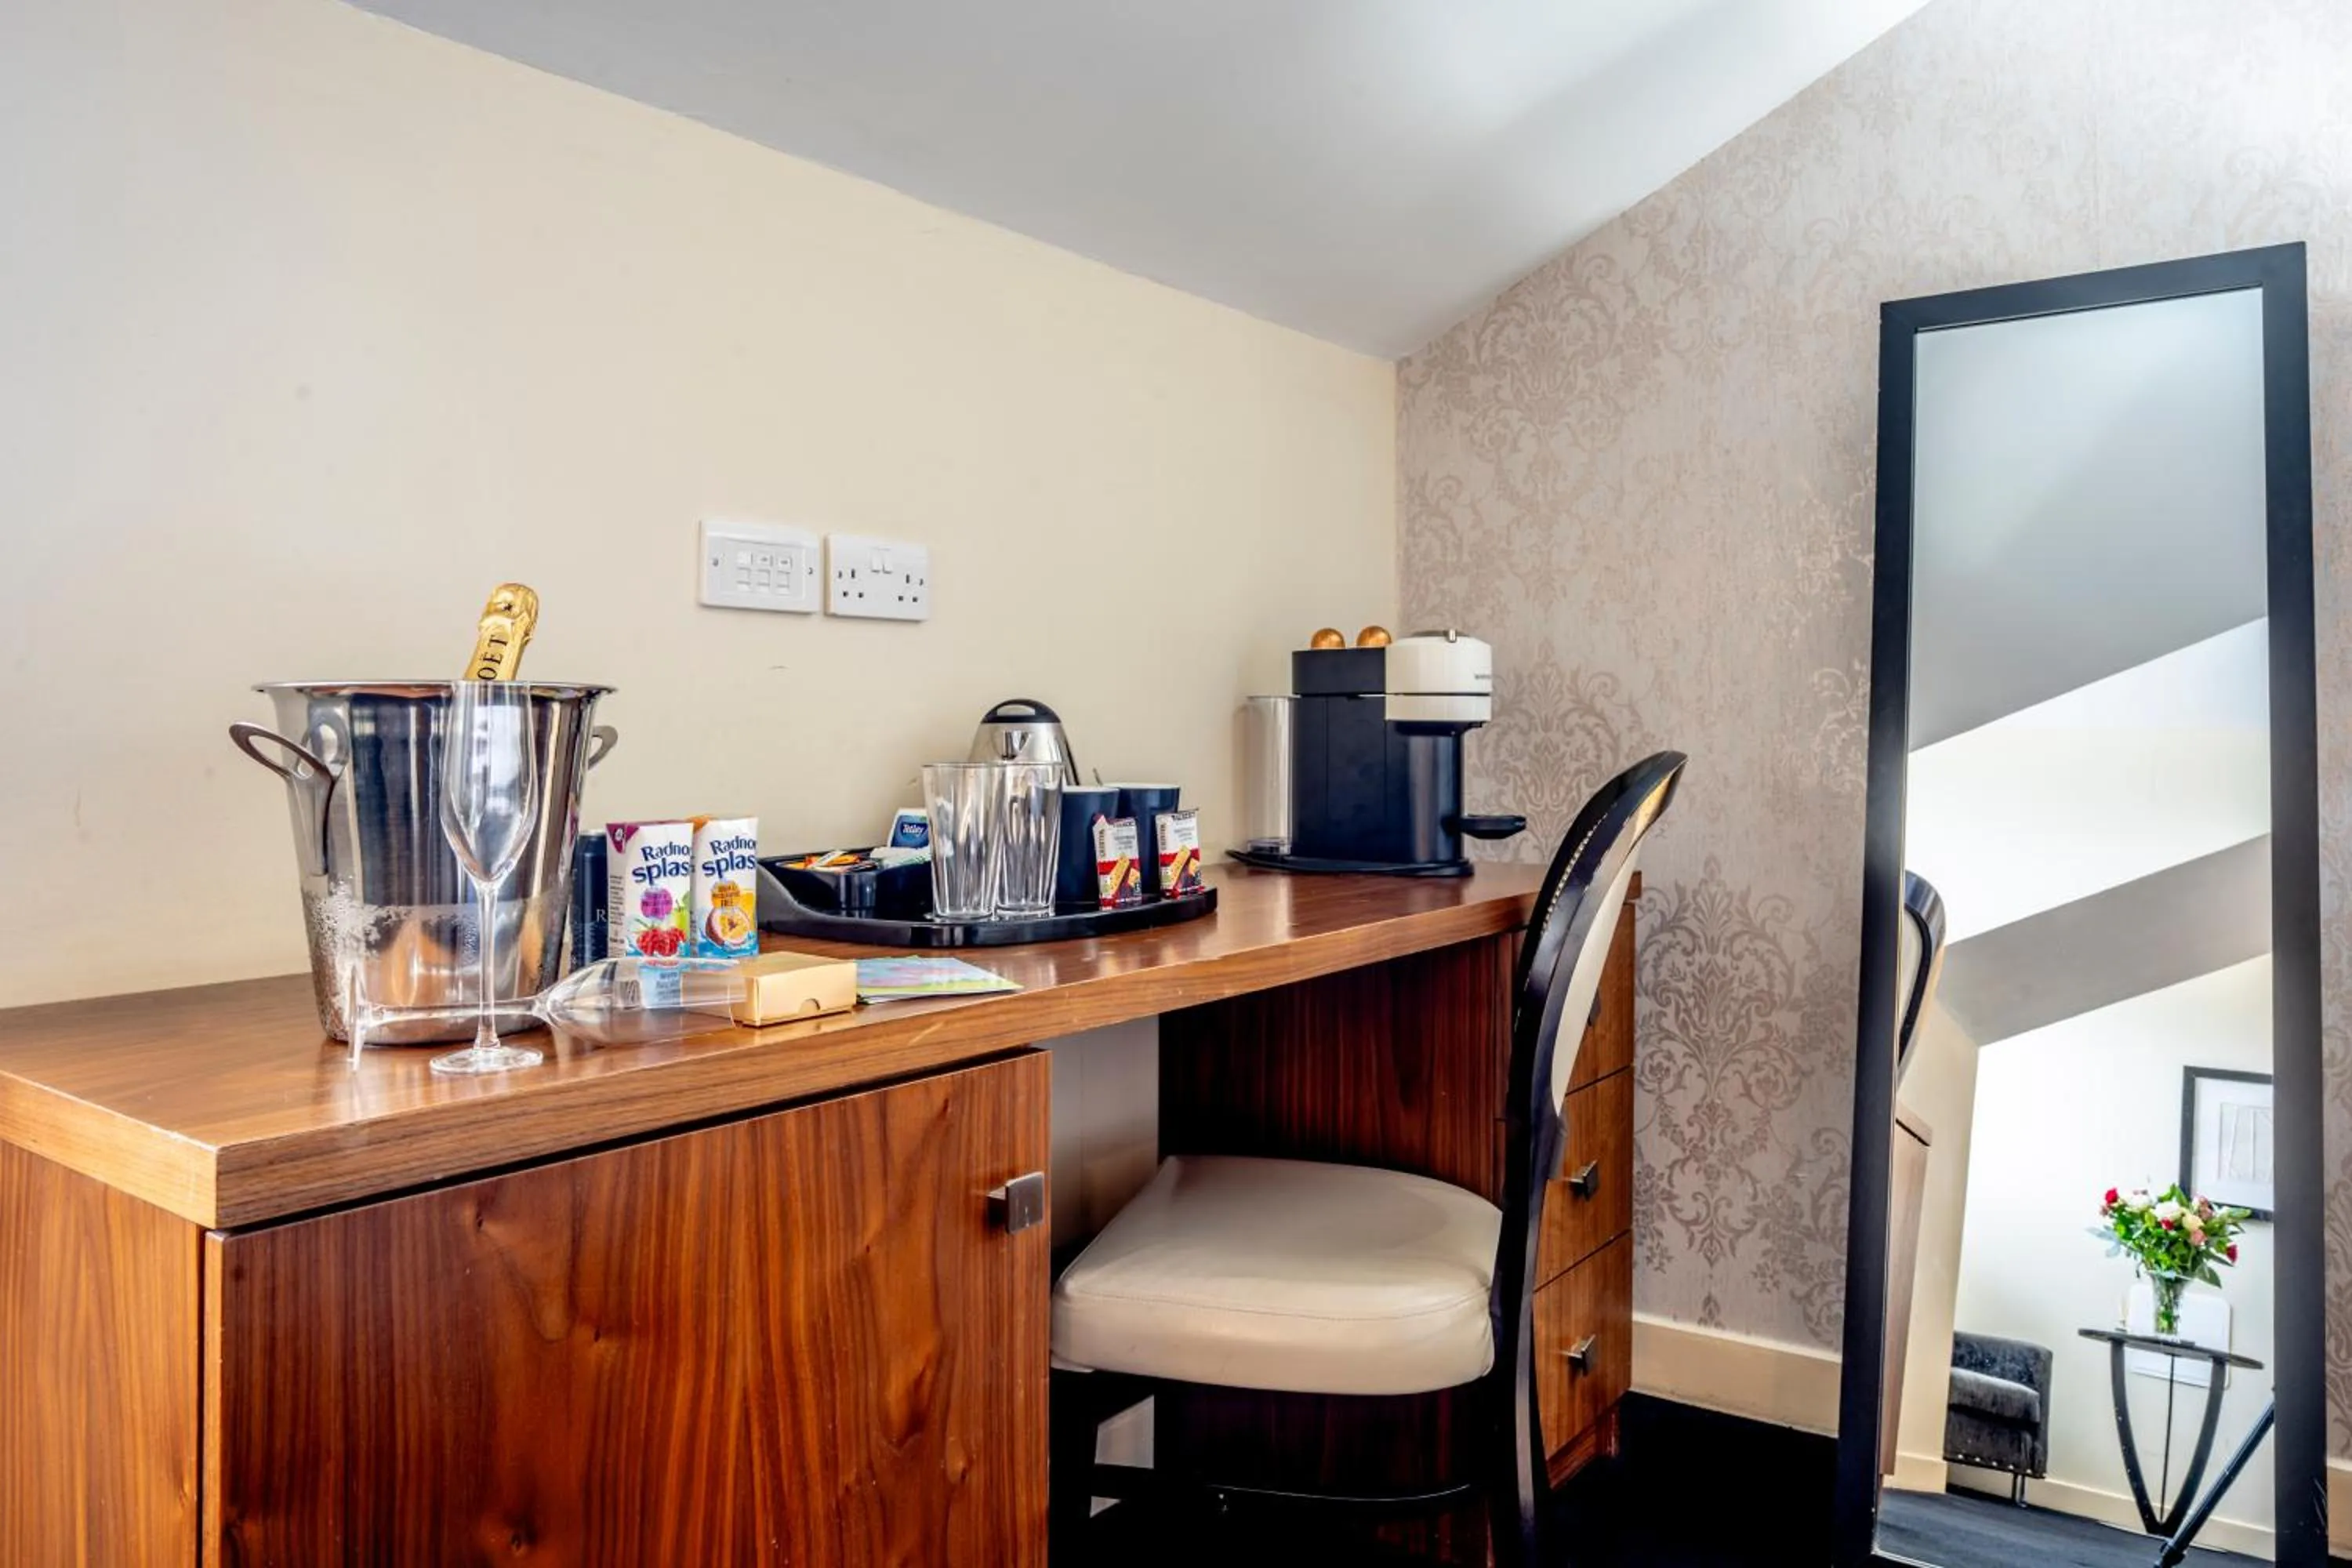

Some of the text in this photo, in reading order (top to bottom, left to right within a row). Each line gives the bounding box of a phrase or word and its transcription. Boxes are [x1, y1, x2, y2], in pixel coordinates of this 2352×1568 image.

[641, 840, 691, 862] Radno
[709, 835, 757, 855] Radno
[631, 858, 691, 885] splas
[702, 851, 757, 879] splas
